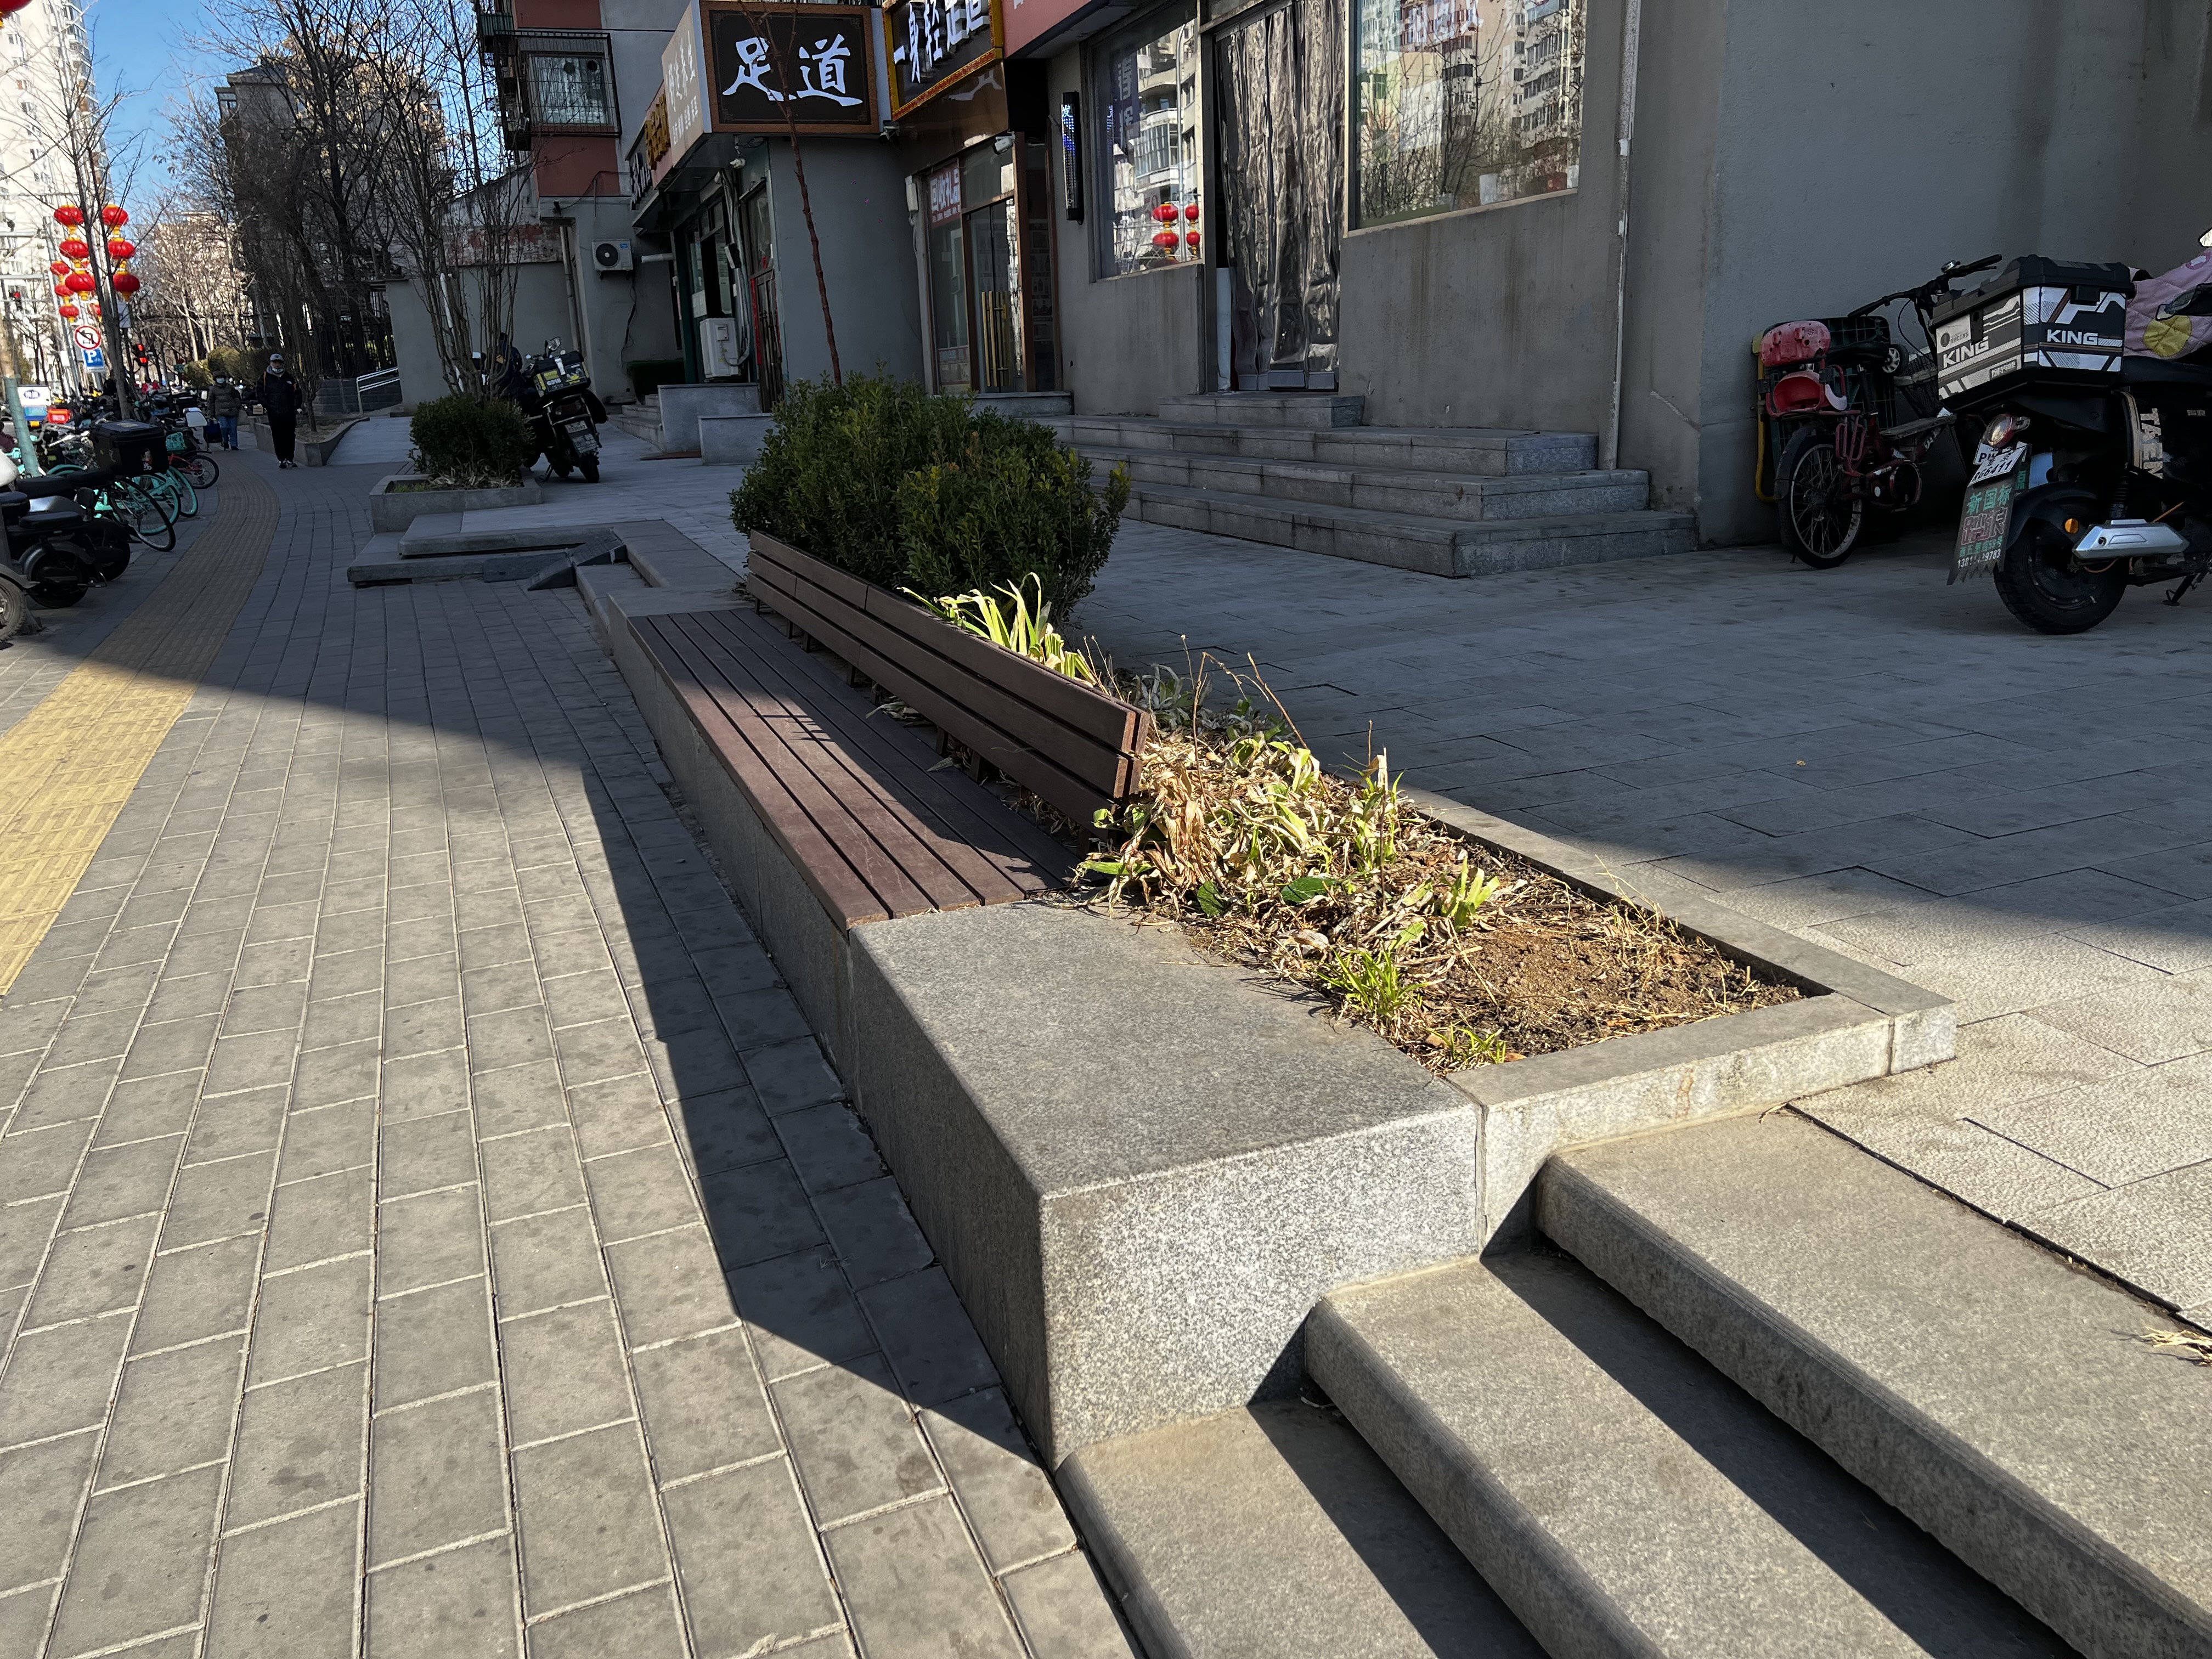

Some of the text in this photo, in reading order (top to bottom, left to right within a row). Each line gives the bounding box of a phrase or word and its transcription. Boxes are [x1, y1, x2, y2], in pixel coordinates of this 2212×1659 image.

[722, 33, 864, 106] 足道
[1943, 336, 1989, 368] KING
[2047, 329, 2098, 346] KING
[86, 349, 97, 363] P
[1966, 484, 2012, 515] 新国标
